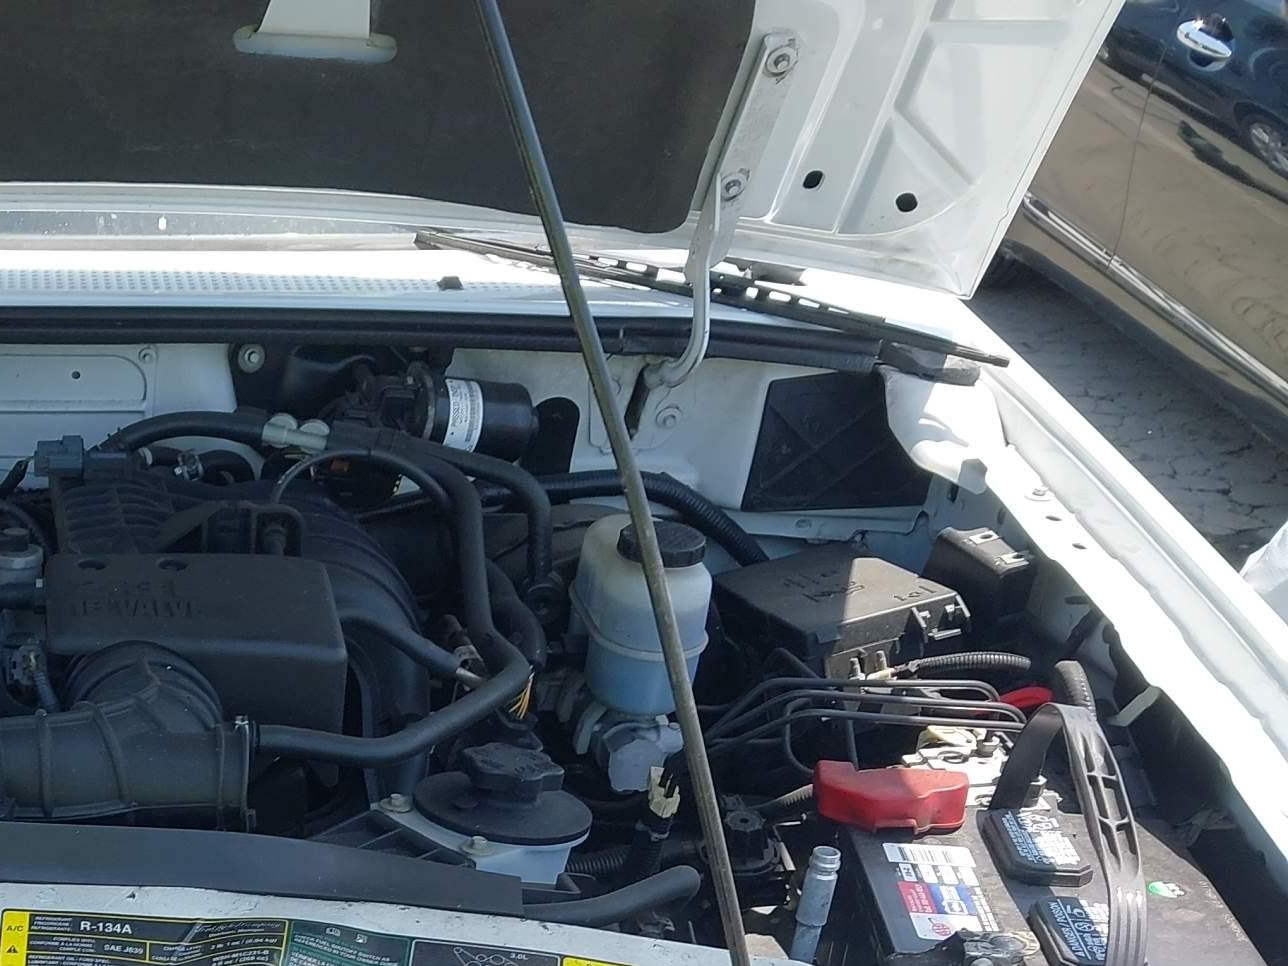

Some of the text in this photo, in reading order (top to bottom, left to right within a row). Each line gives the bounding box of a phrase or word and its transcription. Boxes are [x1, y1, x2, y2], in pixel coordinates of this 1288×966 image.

[80, 921, 133, 934] R-134A
[103, 944, 144, 955] SAE J639
